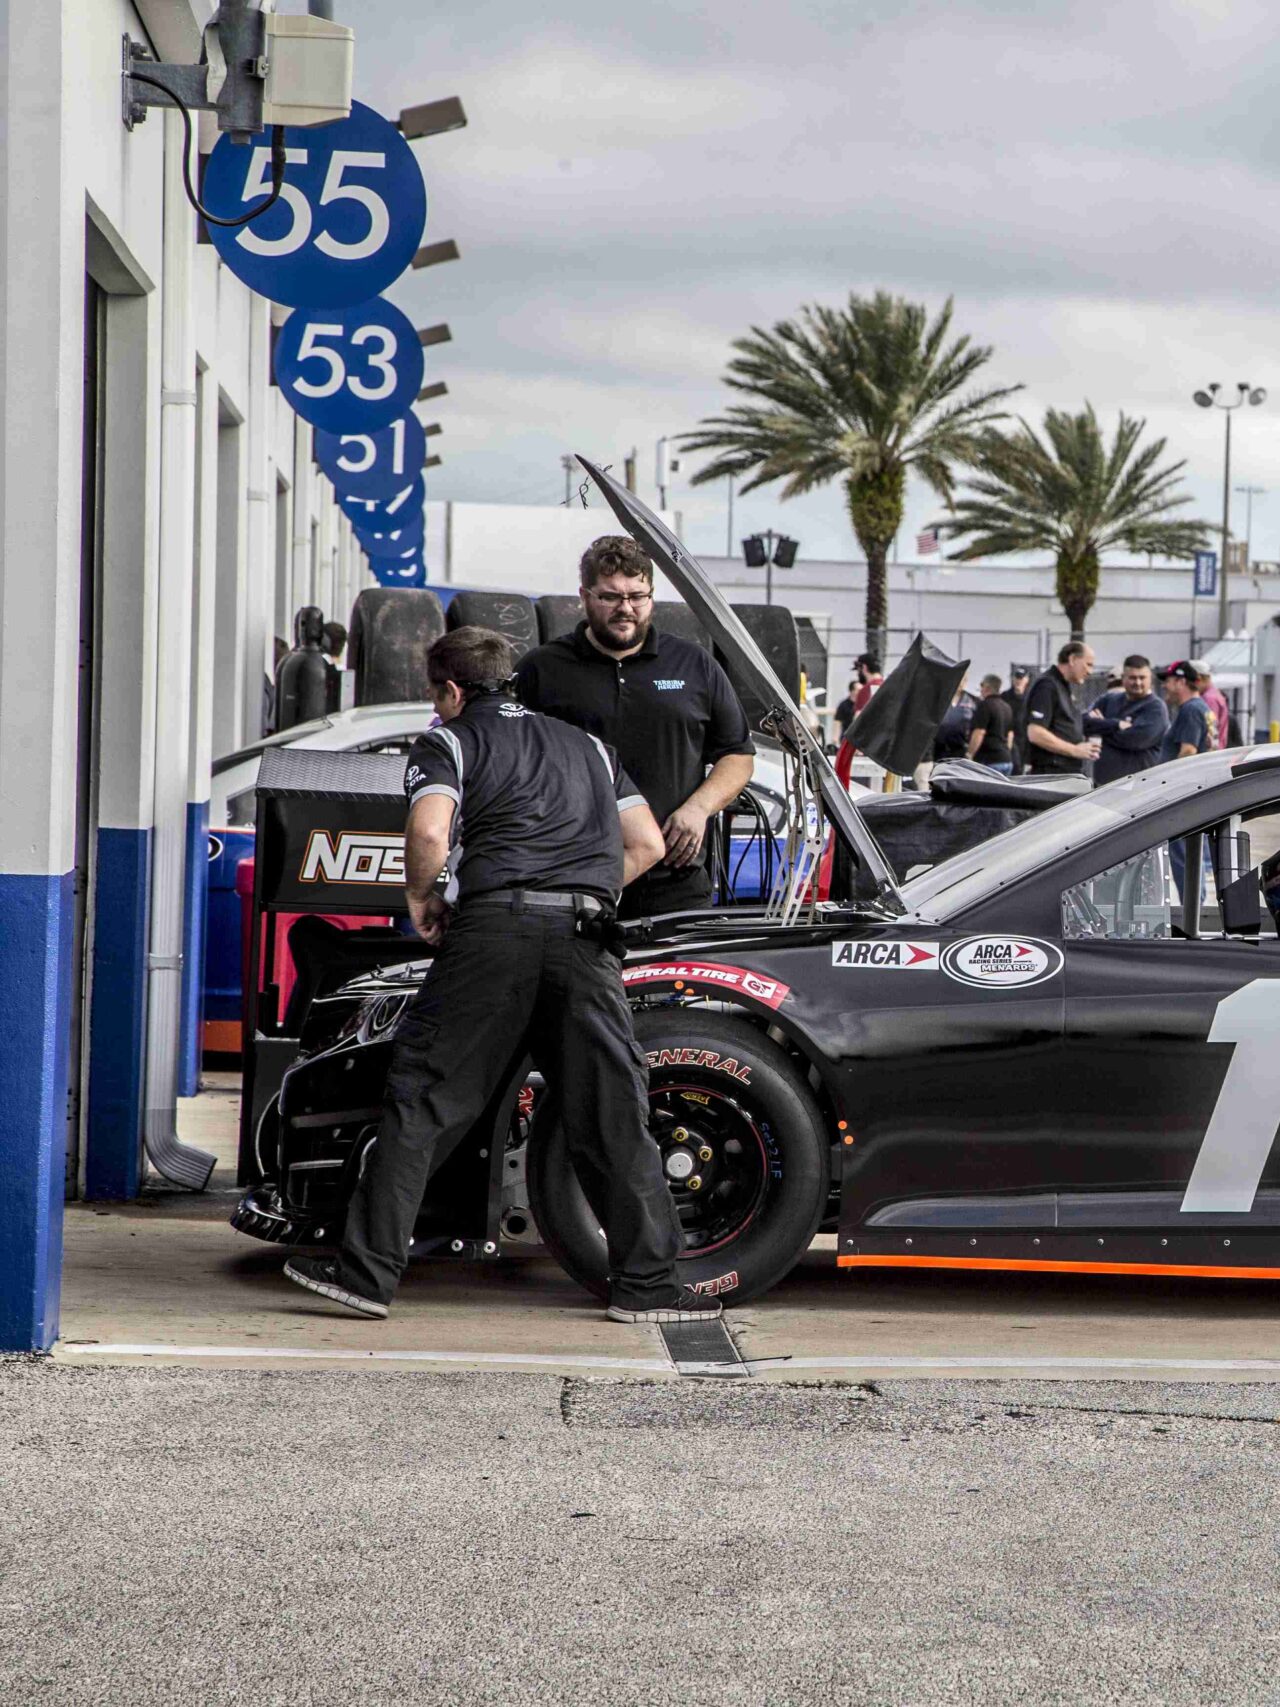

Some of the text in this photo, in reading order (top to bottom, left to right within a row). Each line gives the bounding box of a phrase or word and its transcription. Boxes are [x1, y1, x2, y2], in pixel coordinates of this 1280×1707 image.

[235, 147, 390, 260] 55
[292, 322, 397, 401] 53
[336, 418, 405, 474] 51
[836, 943, 901, 965] ARCA
[974, 945, 1012, 958] ARCA
[620, 967, 741, 985] NERAL TIRE
[646, 1049, 752, 1085] ENERAL
